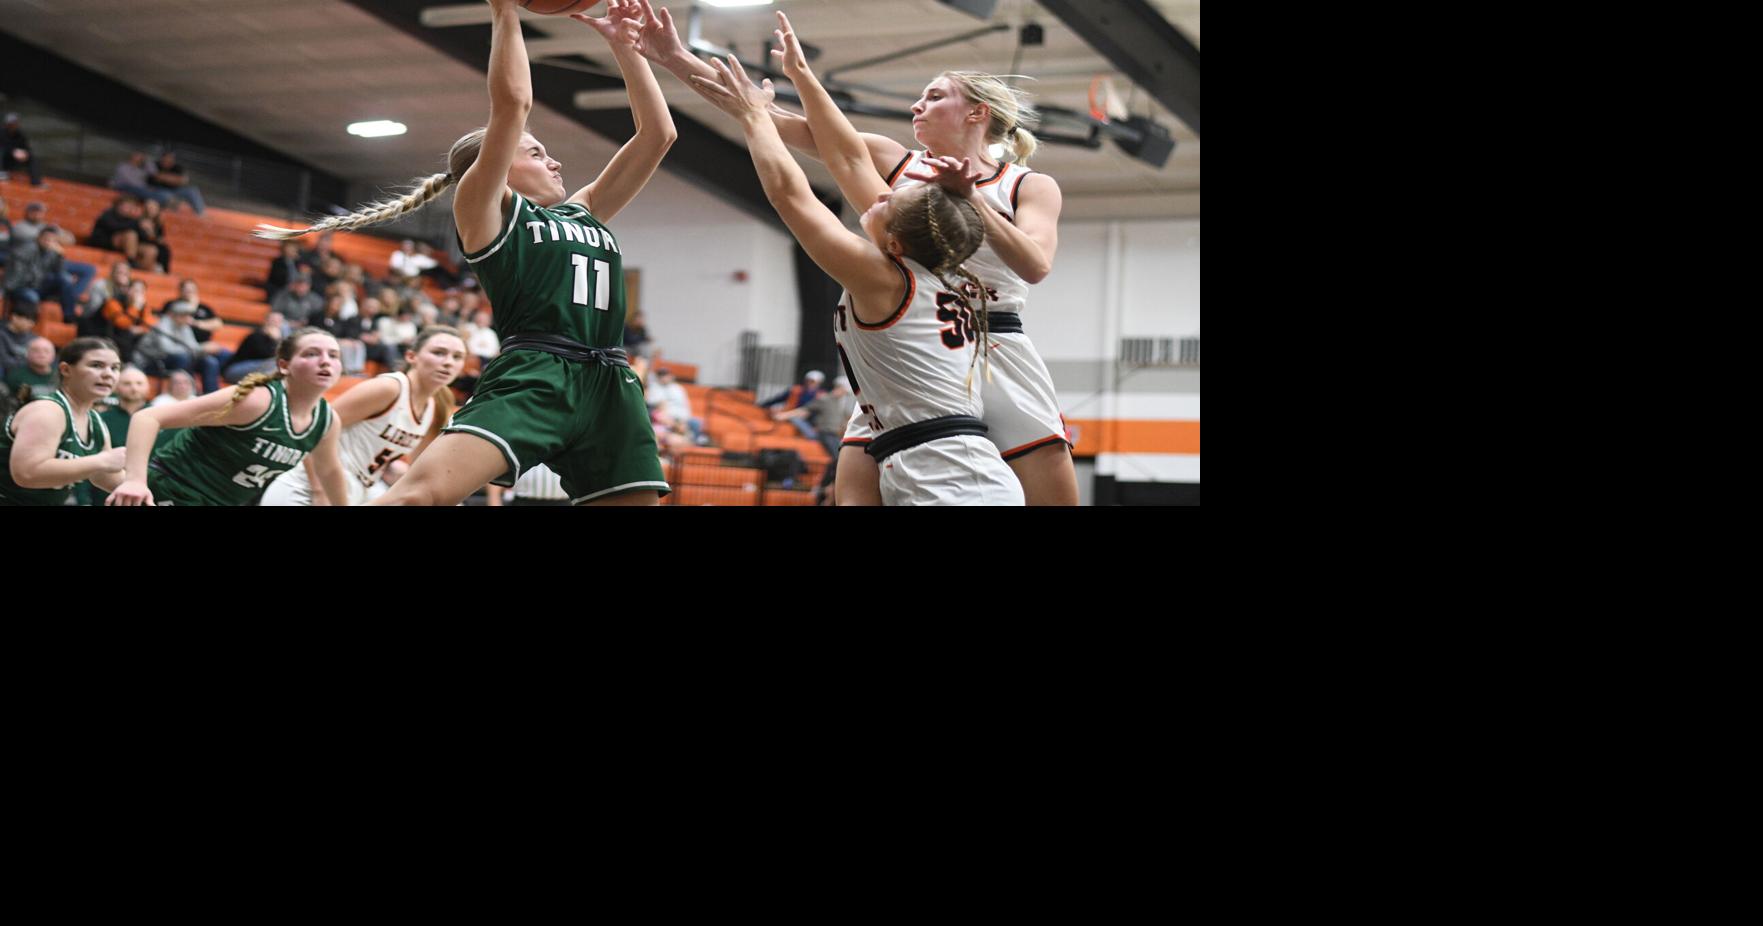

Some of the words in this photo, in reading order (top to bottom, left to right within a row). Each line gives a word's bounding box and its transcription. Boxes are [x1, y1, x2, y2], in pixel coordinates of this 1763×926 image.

[526, 219, 621, 254] TINOR
[571, 253, 610, 311] 11
[251, 436, 309, 466] TINOR
